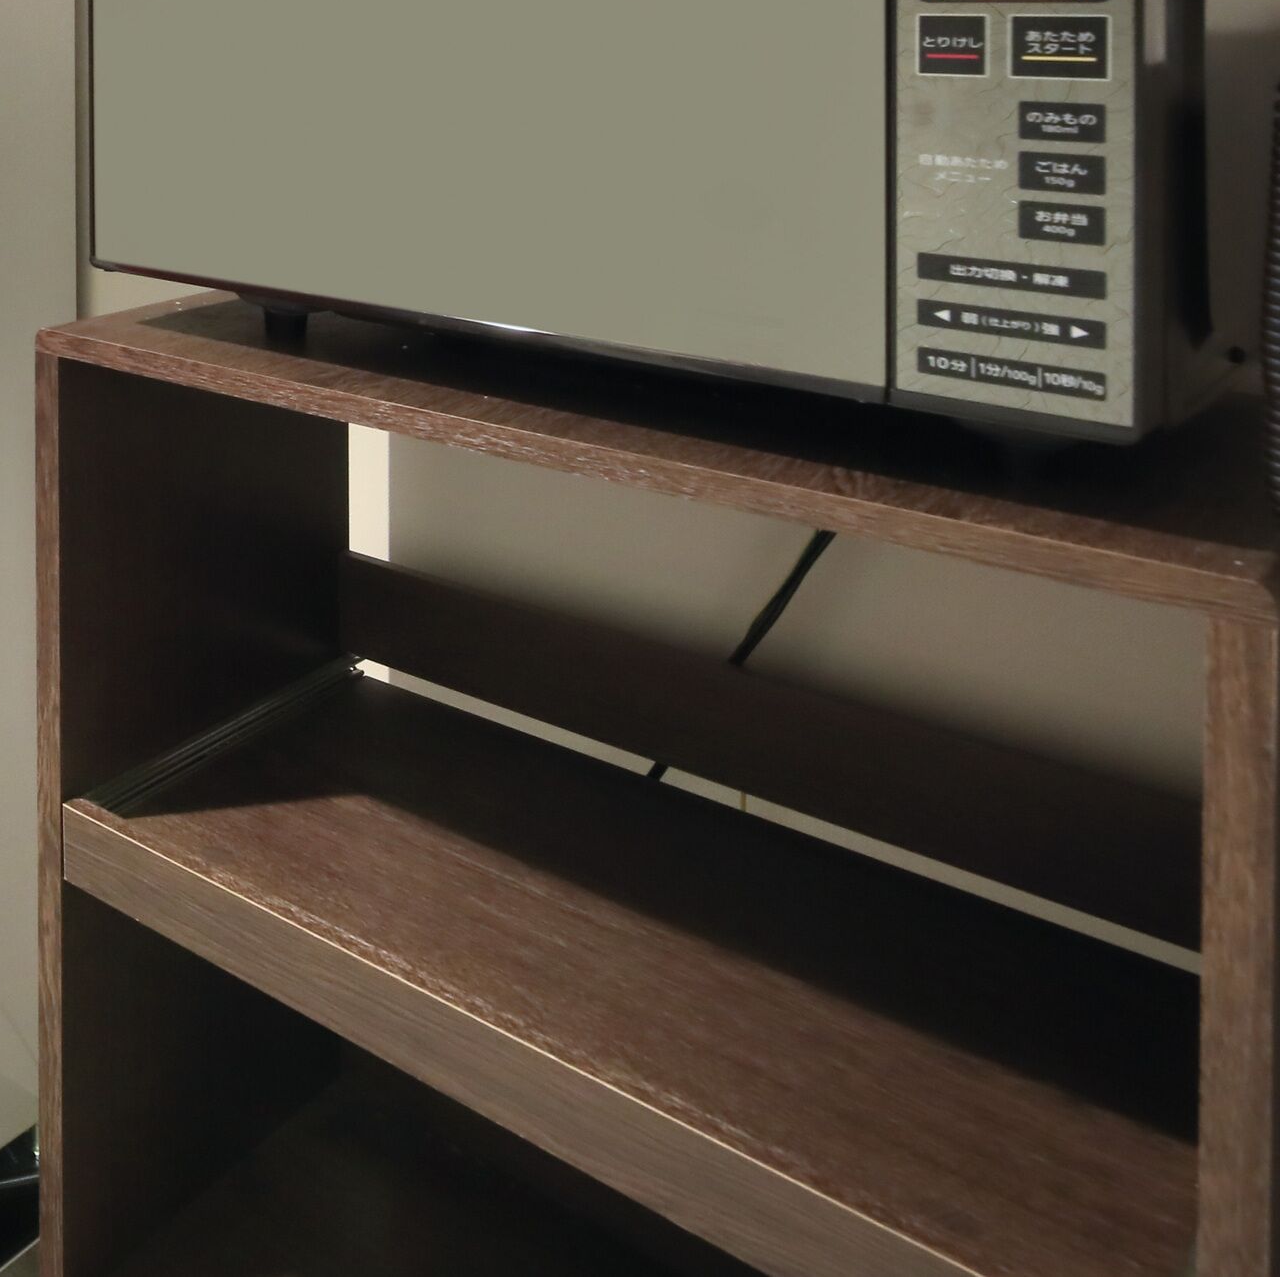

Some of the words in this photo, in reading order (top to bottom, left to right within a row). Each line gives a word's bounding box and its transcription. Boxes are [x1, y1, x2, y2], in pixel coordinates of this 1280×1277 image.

[923, 35, 983, 50] とりけし
[1025, 30, 1096, 44] あたため
[1027, 42, 1093, 55] スタート
[1026, 111, 1097, 126] のみもの
[1035, 160, 1089, 176] ごはん
[934, 171, 992, 183] メニュー
[1044, 175, 1076, 188] 150g
[1035, 210, 1088, 227] お弁当
[1042, 225, 1076, 238] 400g
[926, 355, 968, 374] 10分
